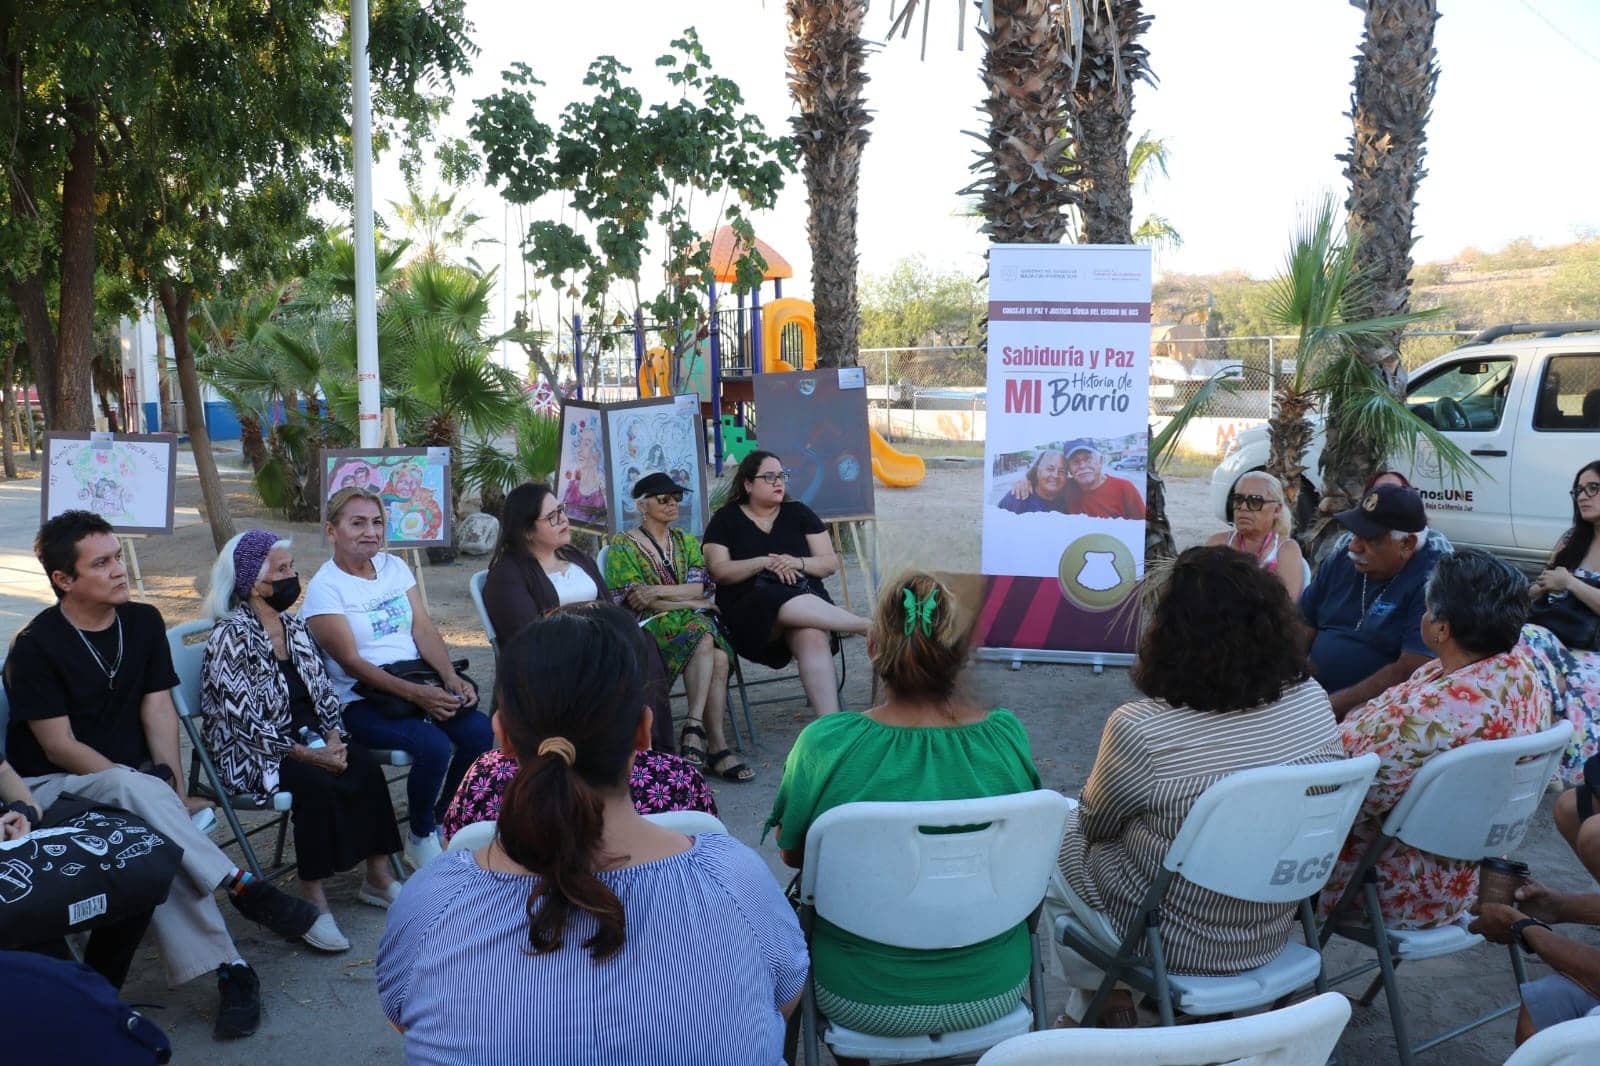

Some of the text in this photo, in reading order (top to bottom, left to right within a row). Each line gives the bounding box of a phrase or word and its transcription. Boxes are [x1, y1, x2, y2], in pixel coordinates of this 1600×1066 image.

[1002, 345, 1135, 369] Sabiduría y Paz
[1071, 371, 1133, 392] Historia de
[1005, 378, 1130, 417] MI Barrio
[1269, 852, 1334, 885] BCS
